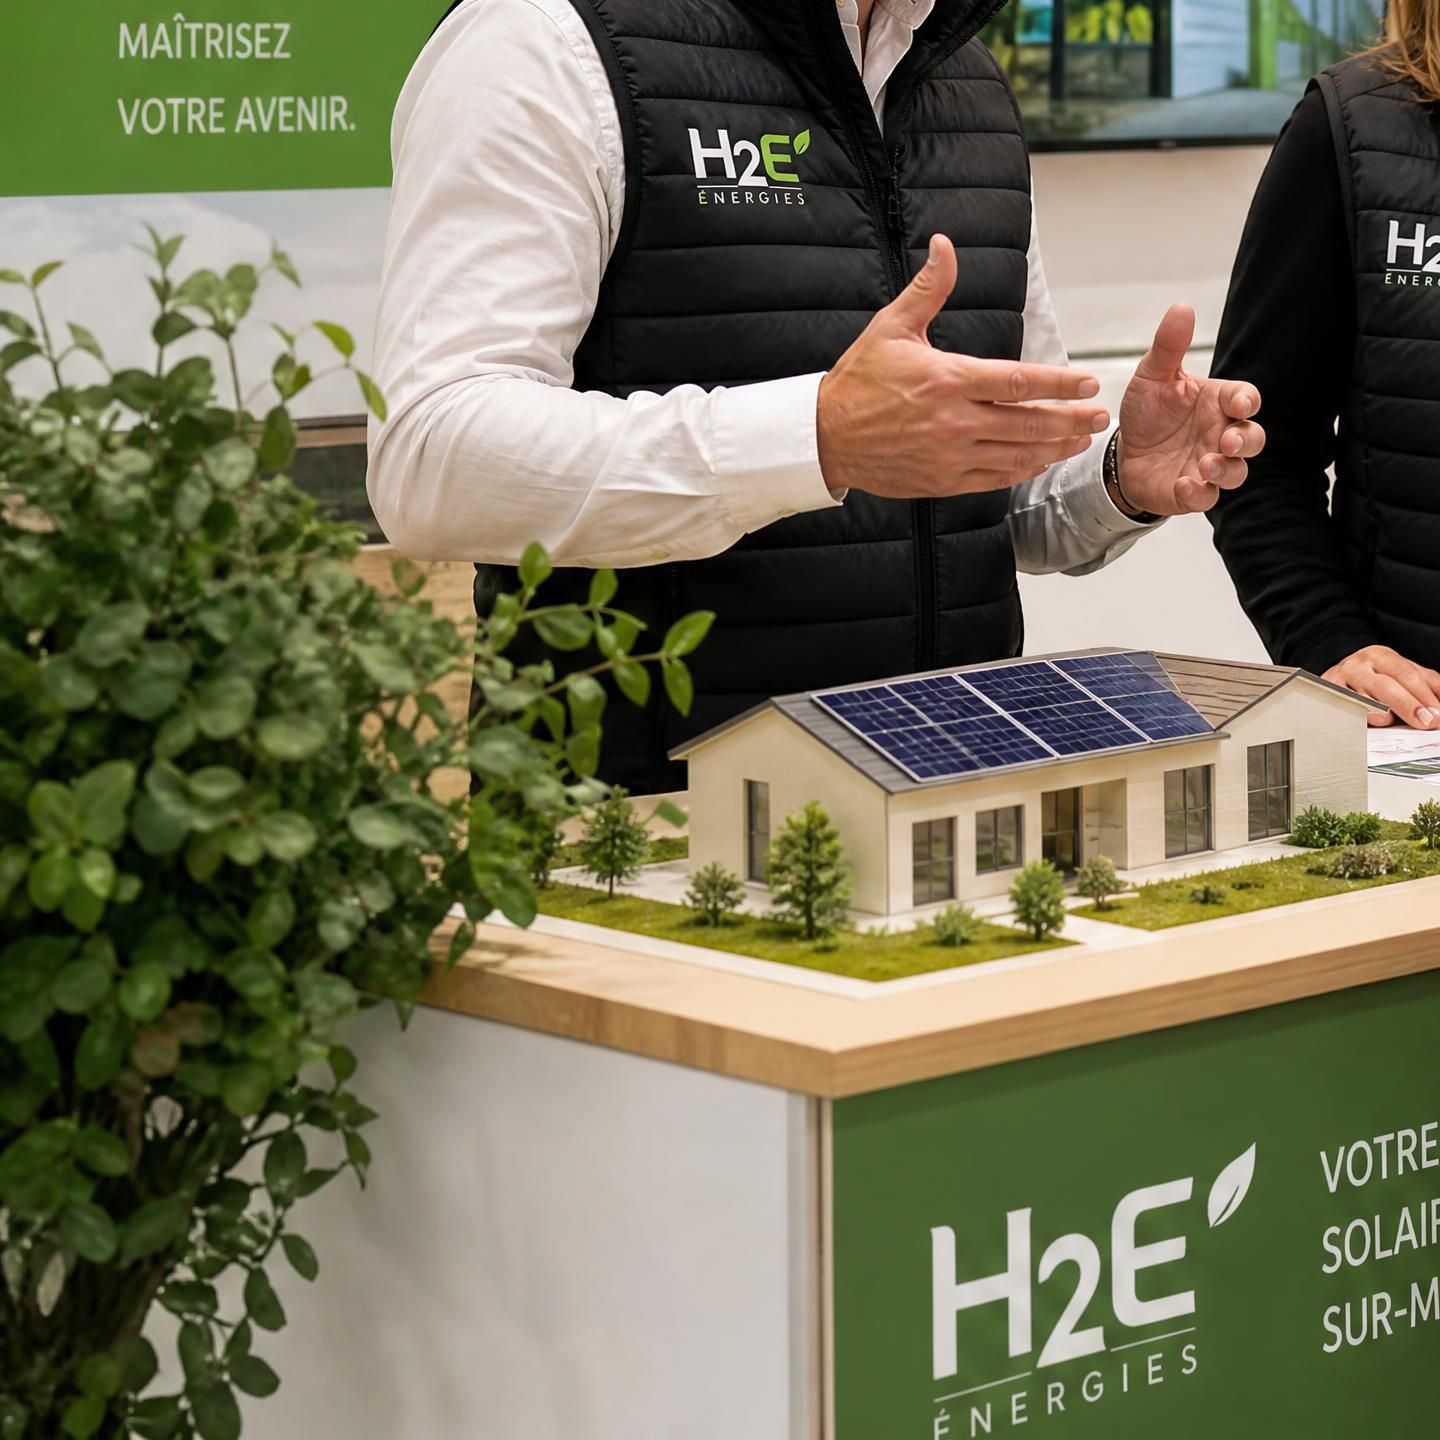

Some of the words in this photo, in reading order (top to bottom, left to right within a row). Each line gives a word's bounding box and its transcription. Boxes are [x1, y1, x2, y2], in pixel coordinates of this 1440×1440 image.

[118, 12, 291, 59] MAÎTRISEZ
[117, 97, 225, 135] VOTRE
[234, 95, 356, 133] AVENIR.
[687, 127, 800, 187] H2E
[698, 189, 805, 205] ÉNERGIES
[1320, 1121, 1440, 1193] VOTRE
[930, 1176, 1196, 1381] H2E
[933, 1344, 1198, 1440] ÉNERGIES
